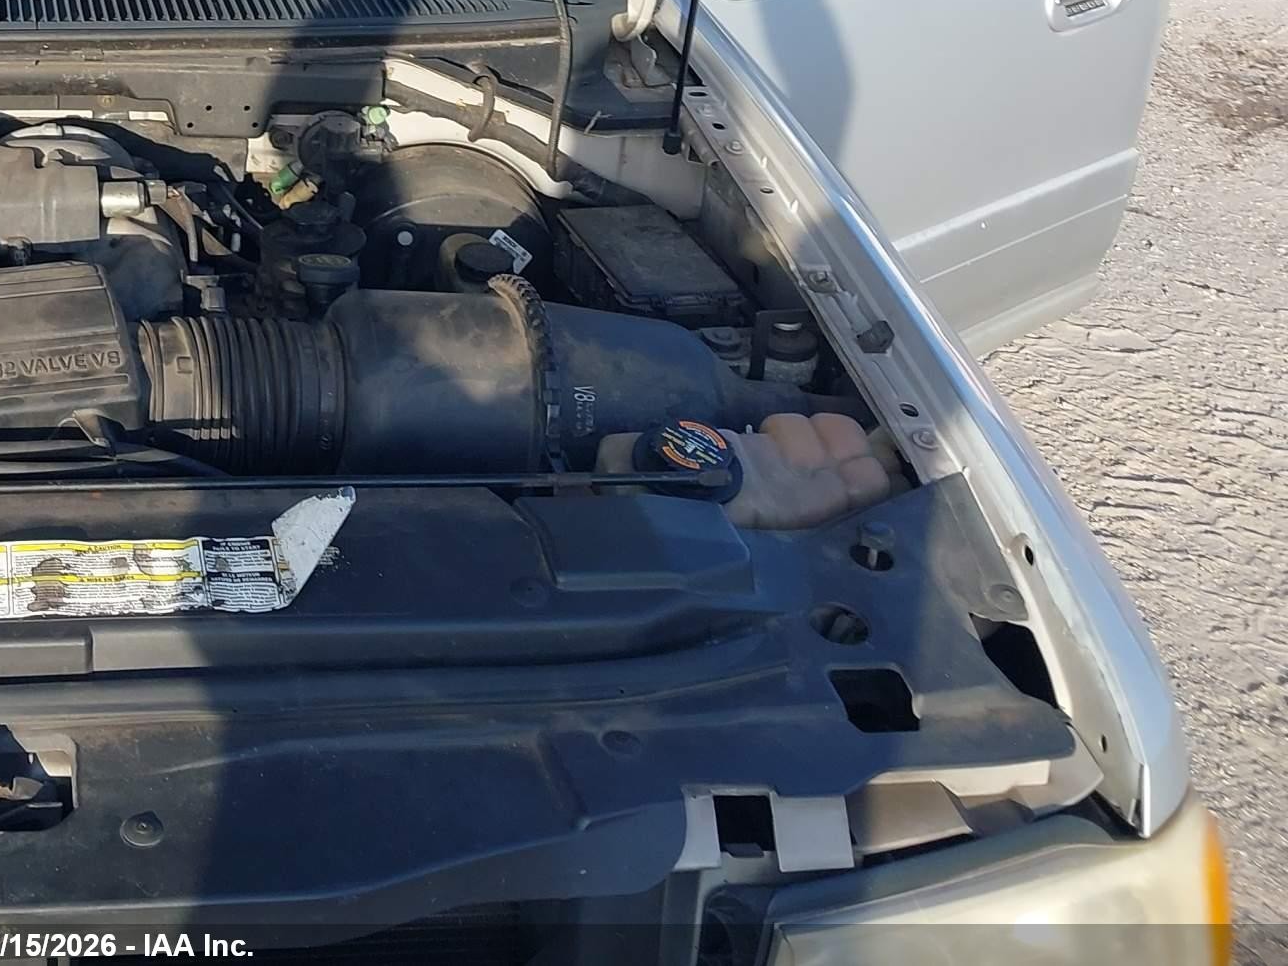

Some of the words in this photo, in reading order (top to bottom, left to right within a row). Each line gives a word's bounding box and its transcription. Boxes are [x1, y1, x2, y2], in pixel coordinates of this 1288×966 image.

[20, 353, 88, 376] VALVE
[90, 349, 122, 369] V8
[573, 385, 597, 402] V8
